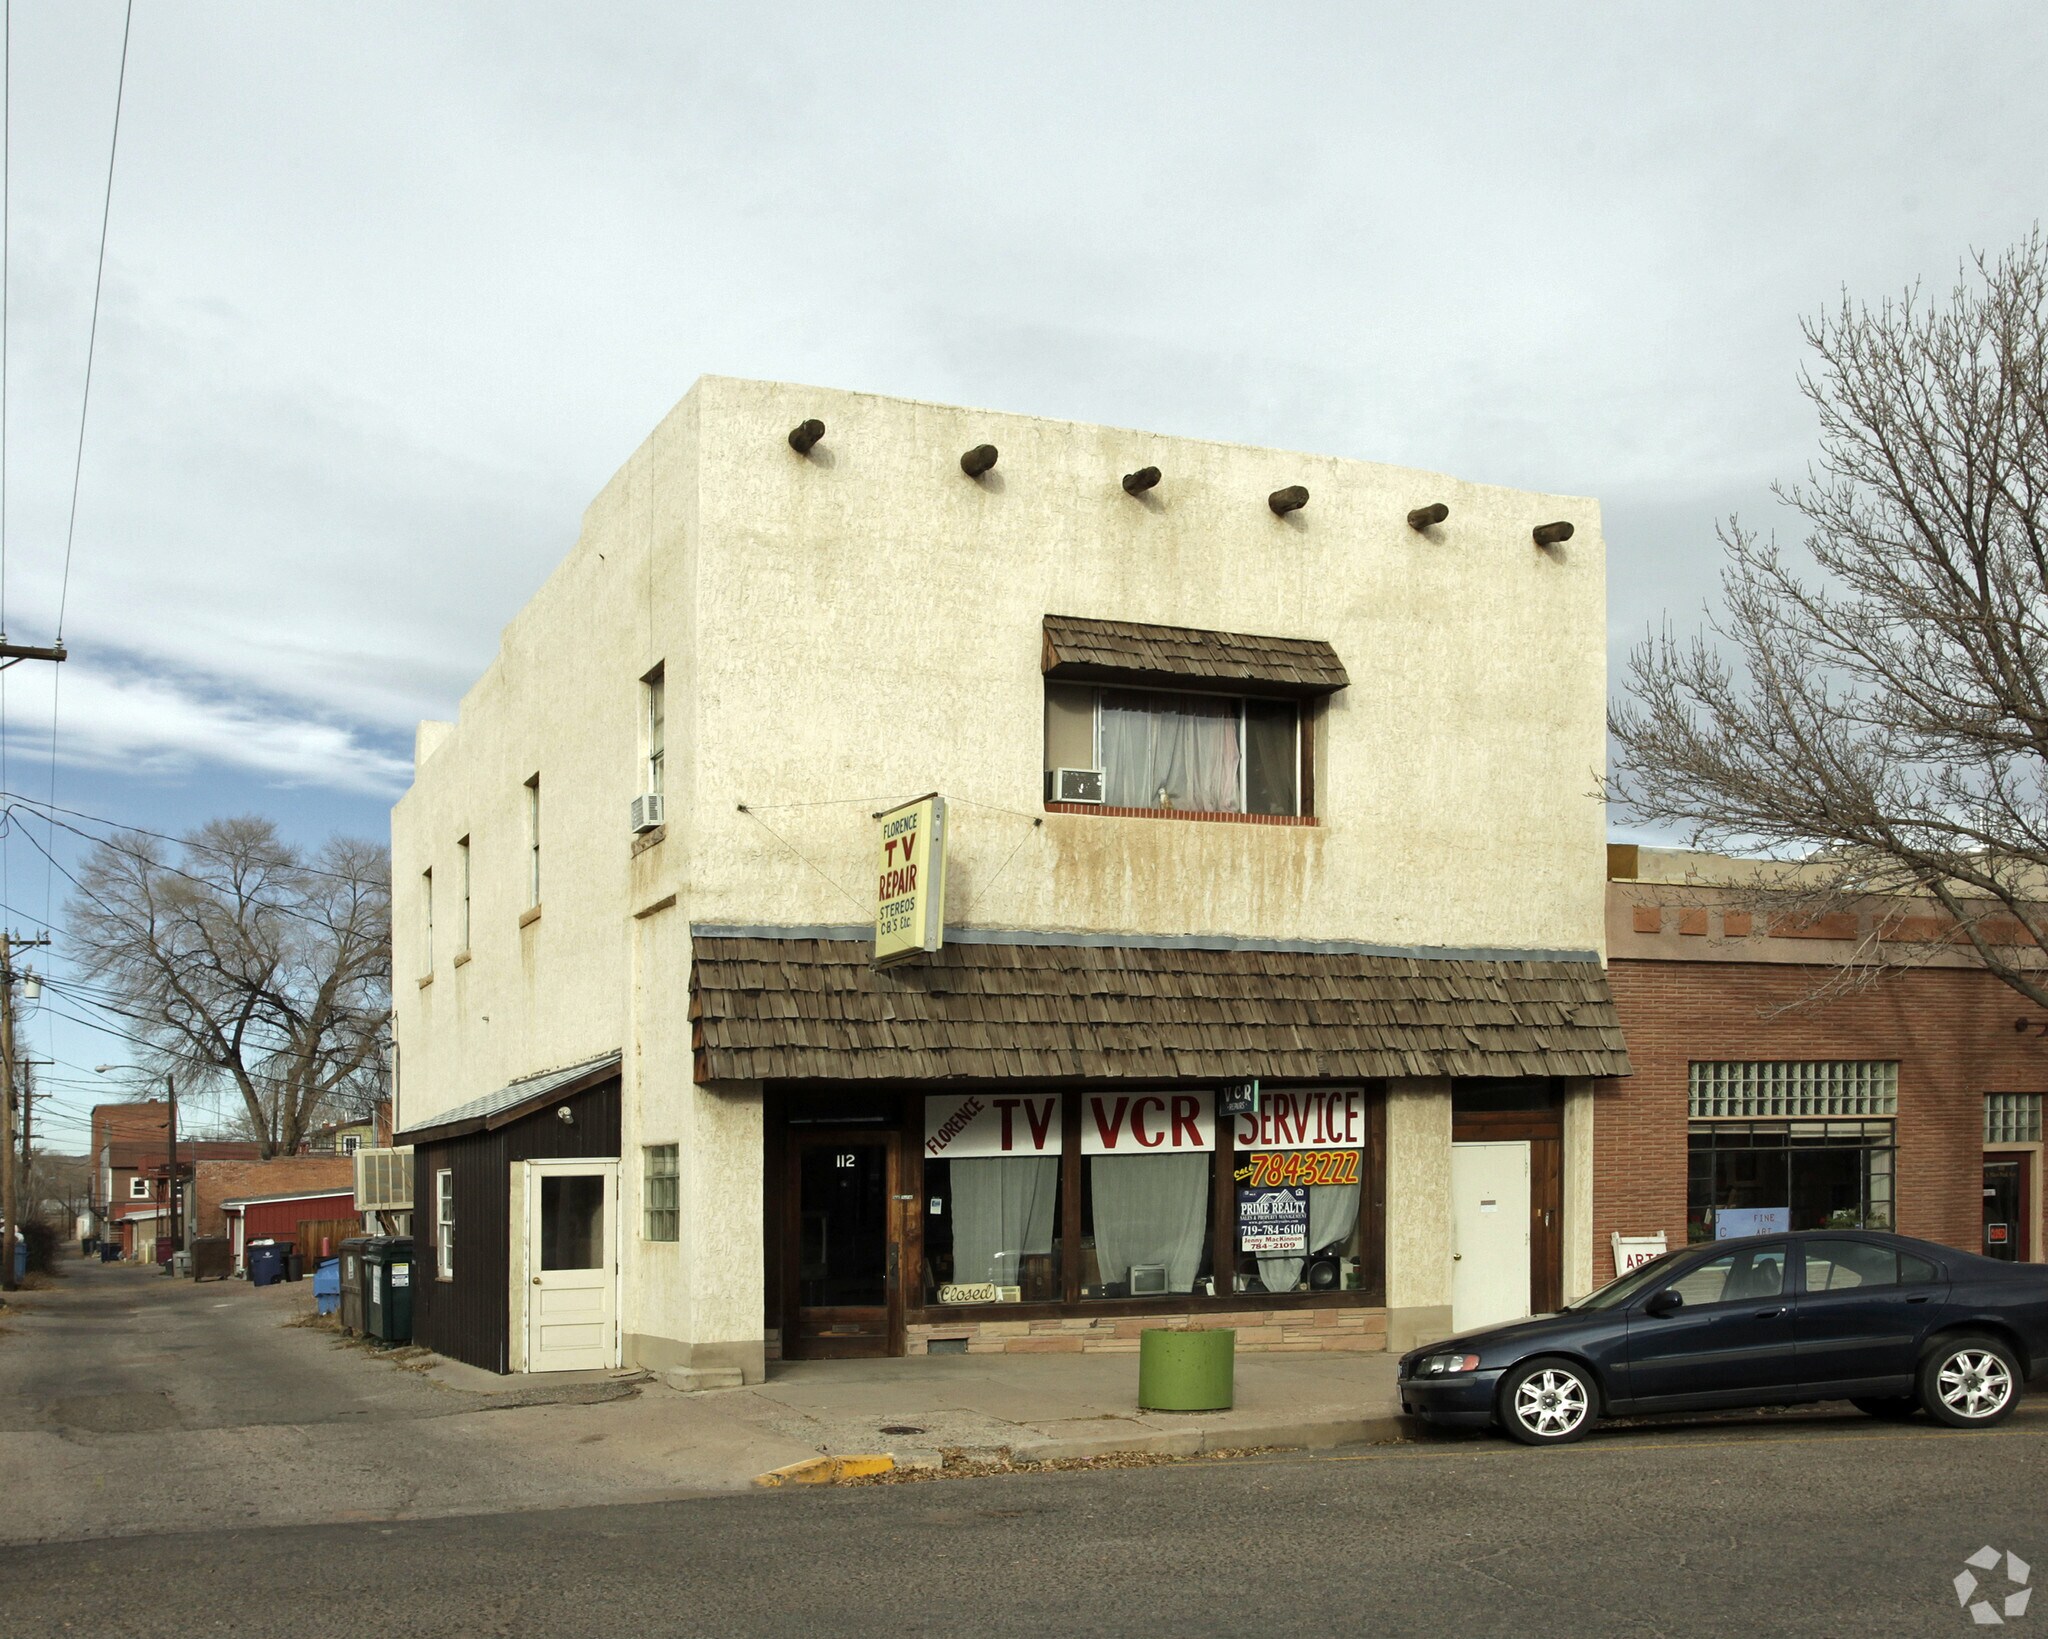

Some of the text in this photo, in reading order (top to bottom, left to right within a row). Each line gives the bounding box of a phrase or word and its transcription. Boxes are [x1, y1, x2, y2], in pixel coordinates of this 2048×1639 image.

[883, 813, 918, 840] FLORENCE
[884, 832, 916, 868] TV
[879, 864, 917, 902] REPAIR
[880, 897, 915, 920] STEREOS
[1223, 1084, 1252, 1102] VCR
[925, 1091, 1359, 1156] FLORENCE TV VCR SERVICE
[836, 1154, 856, 1168] 112
[1234, 1151, 1360, 1187] CALL 784-3222
[1241, 1201, 1306, 1215] PRIME REALTY
[1753, 1213, 1775, 1223] FINE
[1241, 1224, 1306, 1236] 719-784-6100
[1251, 1242, 1296, 1250] 784-2109
[1626, 1253, 1662, 1269] ART
[940, 1284, 993, 1302] Closed
